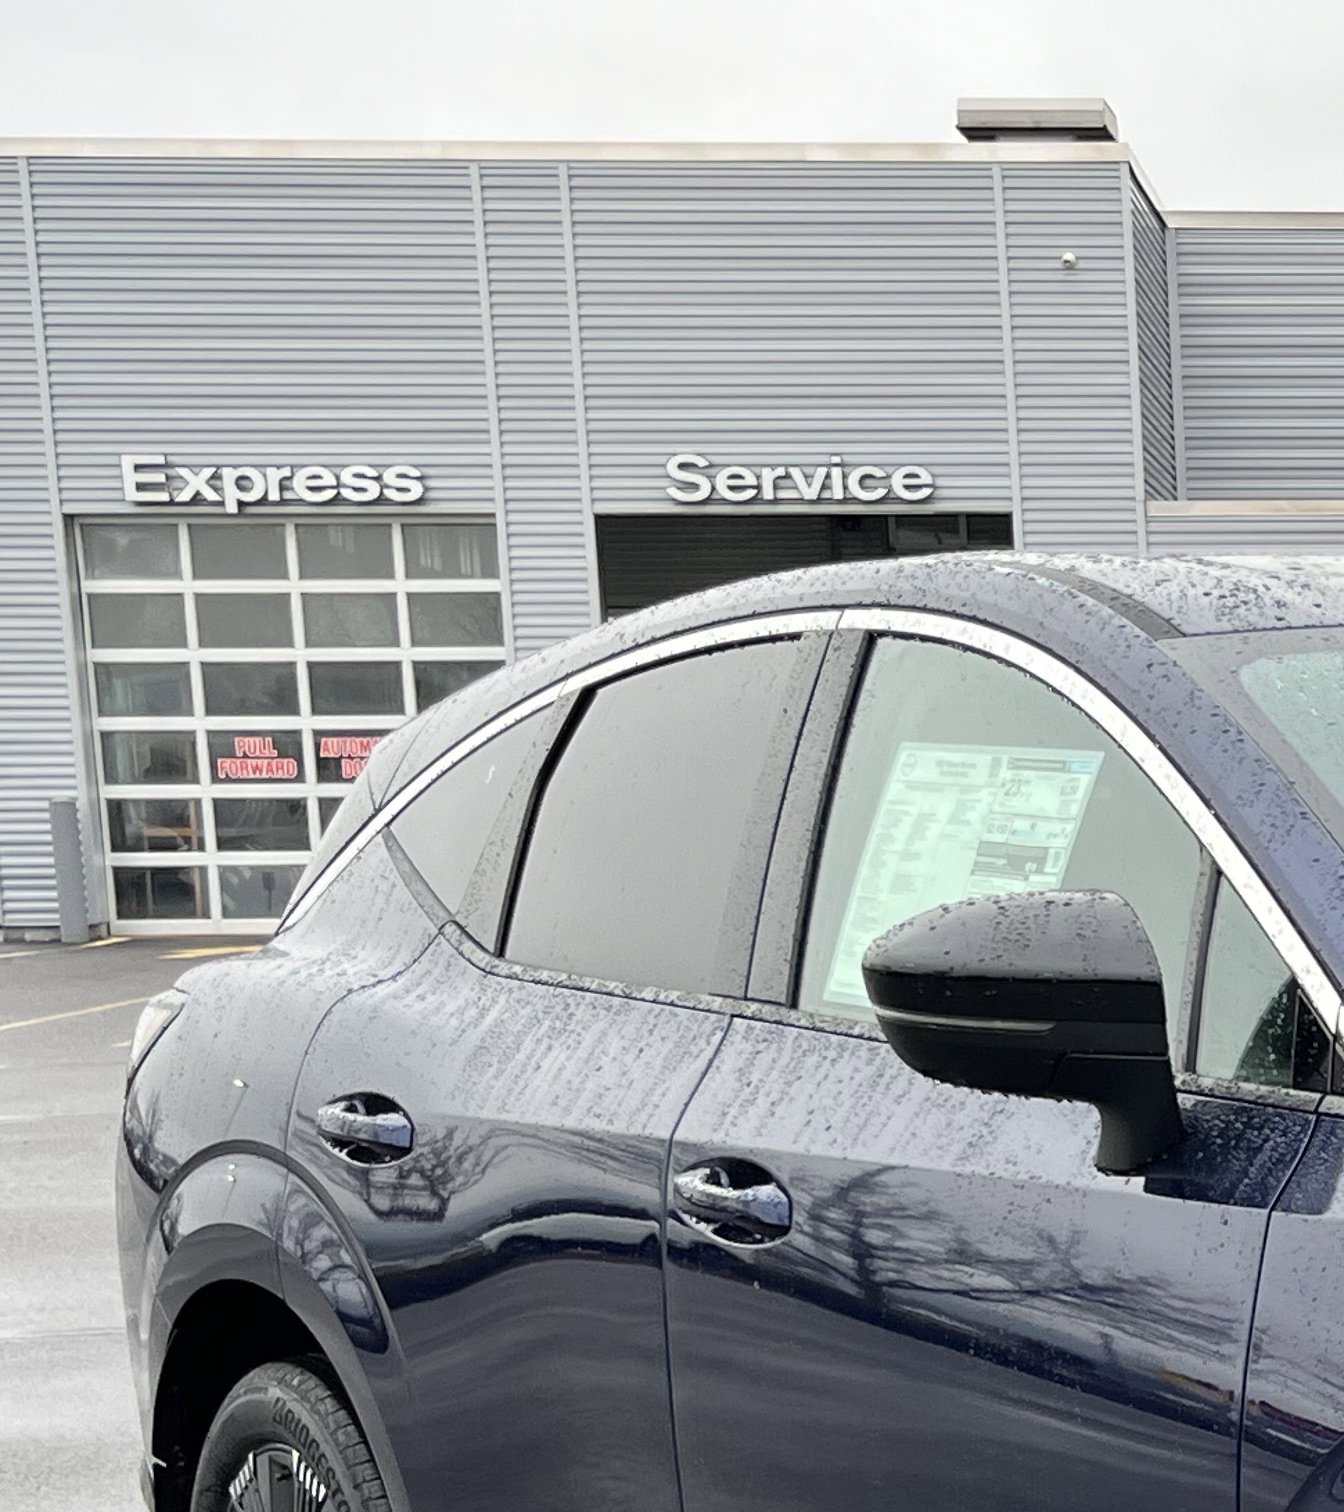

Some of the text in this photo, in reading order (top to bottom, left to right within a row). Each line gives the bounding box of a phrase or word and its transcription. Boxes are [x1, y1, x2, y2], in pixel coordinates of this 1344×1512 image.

[120, 453, 426, 514] Express
[665, 453, 935, 502] Service
[234, 737, 277, 756] PULL
[217, 758, 298, 778] FORWARD
